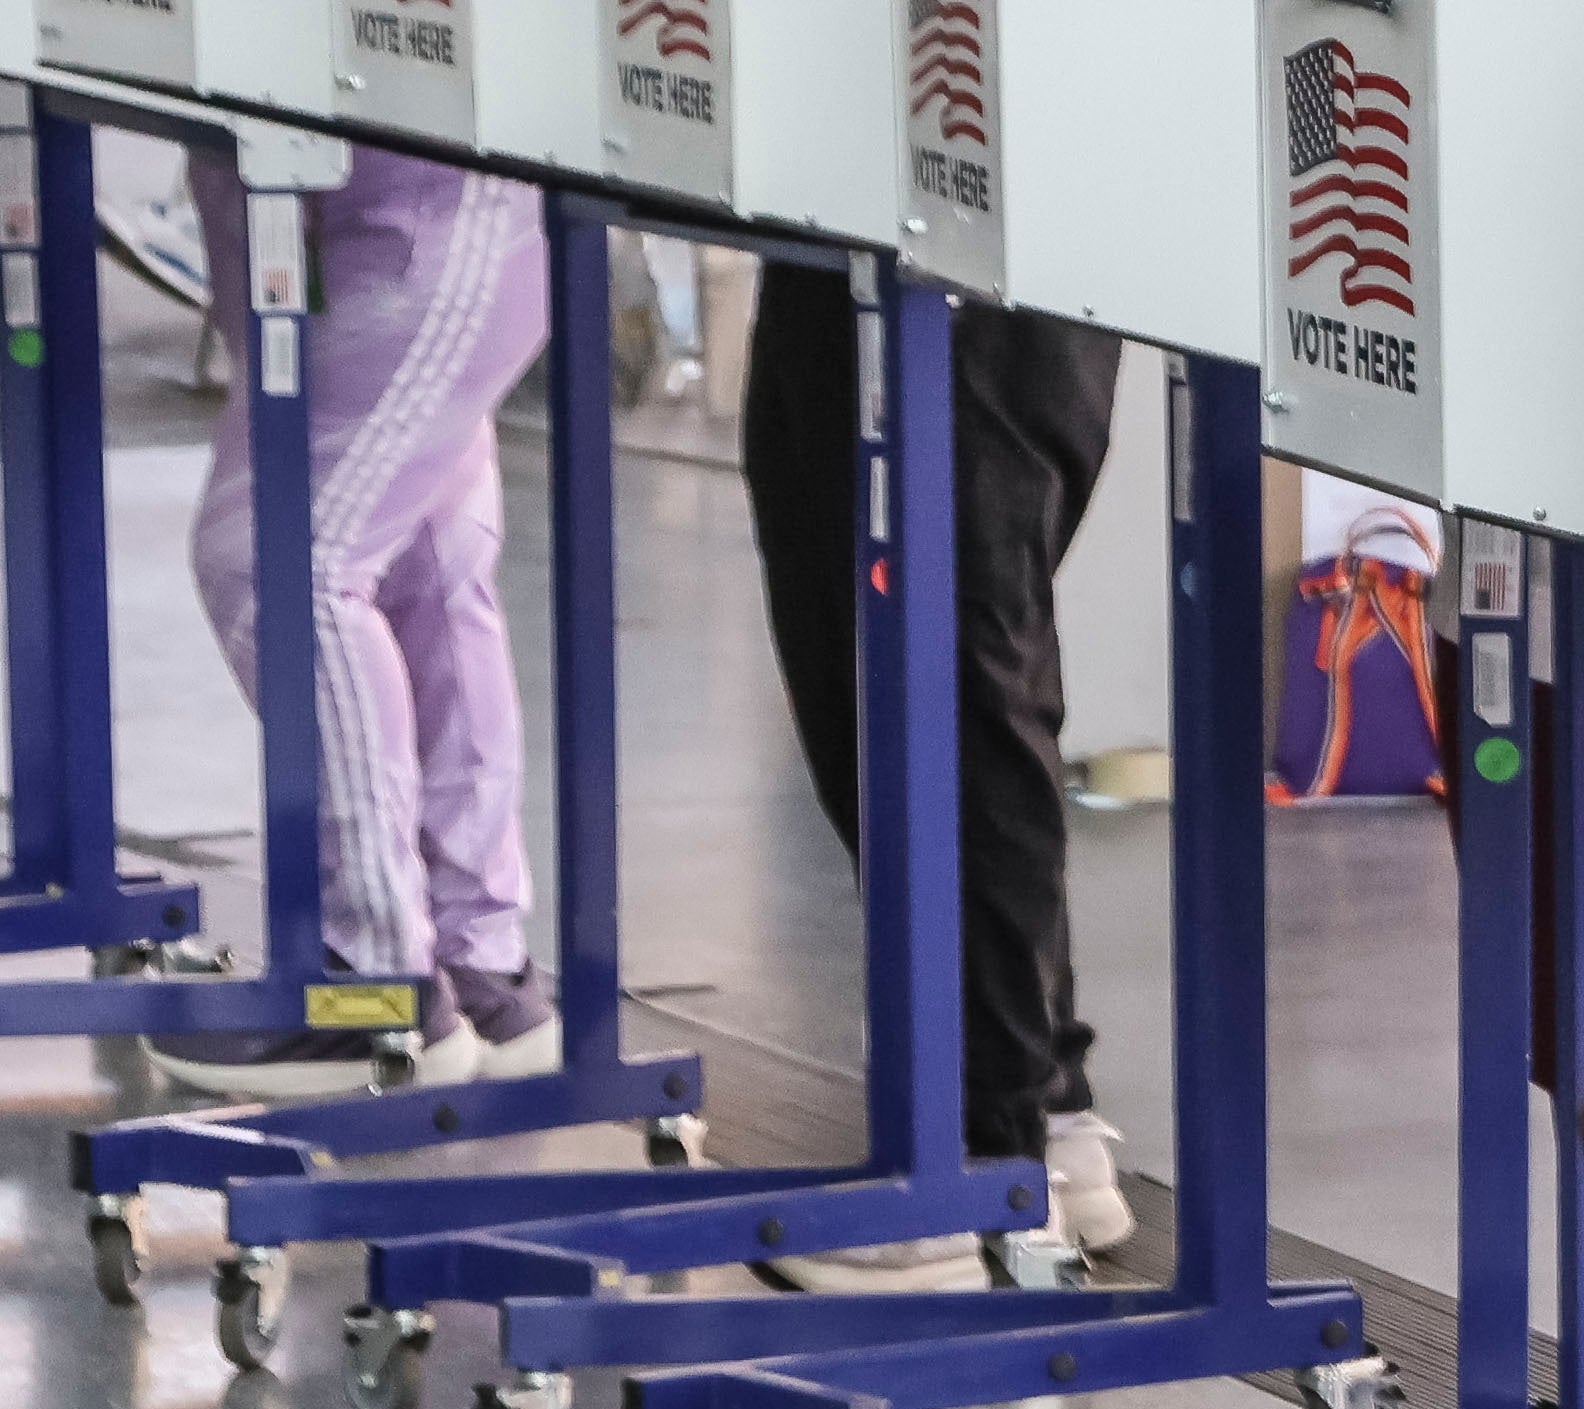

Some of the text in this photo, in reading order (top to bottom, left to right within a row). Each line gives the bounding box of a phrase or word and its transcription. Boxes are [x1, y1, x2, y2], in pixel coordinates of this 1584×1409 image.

[351, 8, 455, 65] VOTE HERE
[617, 62, 713, 124] VOTE HERE
[909, 144, 990, 212] VOTE HERE
[1287, 307, 1417, 396] VOTE HERE
